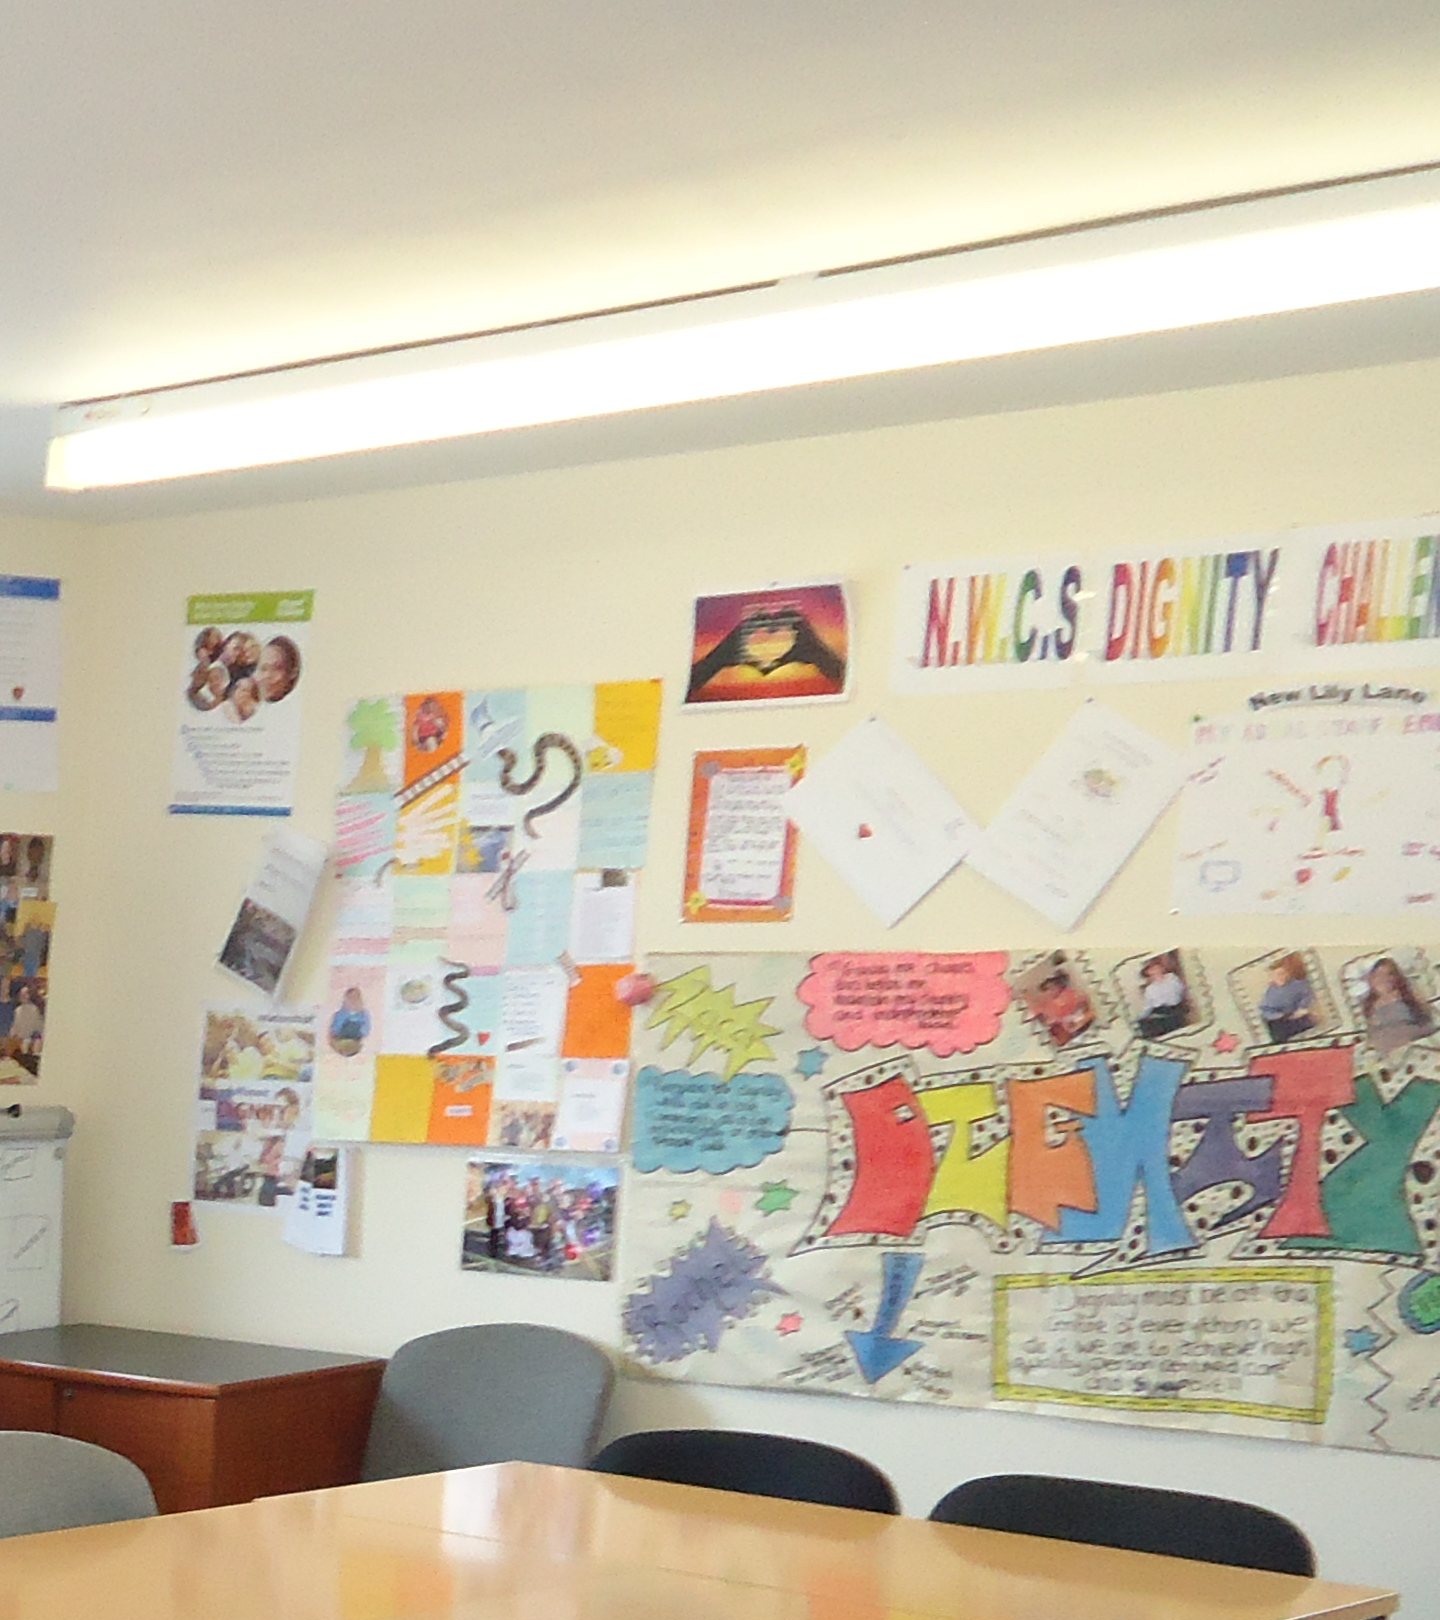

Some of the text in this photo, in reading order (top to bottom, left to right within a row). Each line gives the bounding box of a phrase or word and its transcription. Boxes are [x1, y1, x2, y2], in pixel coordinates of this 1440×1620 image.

[919, 534, 1440, 668] N.W.C.S DIGNITY CHALLE
[1248, 682, 1429, 711] New Lily Lane
